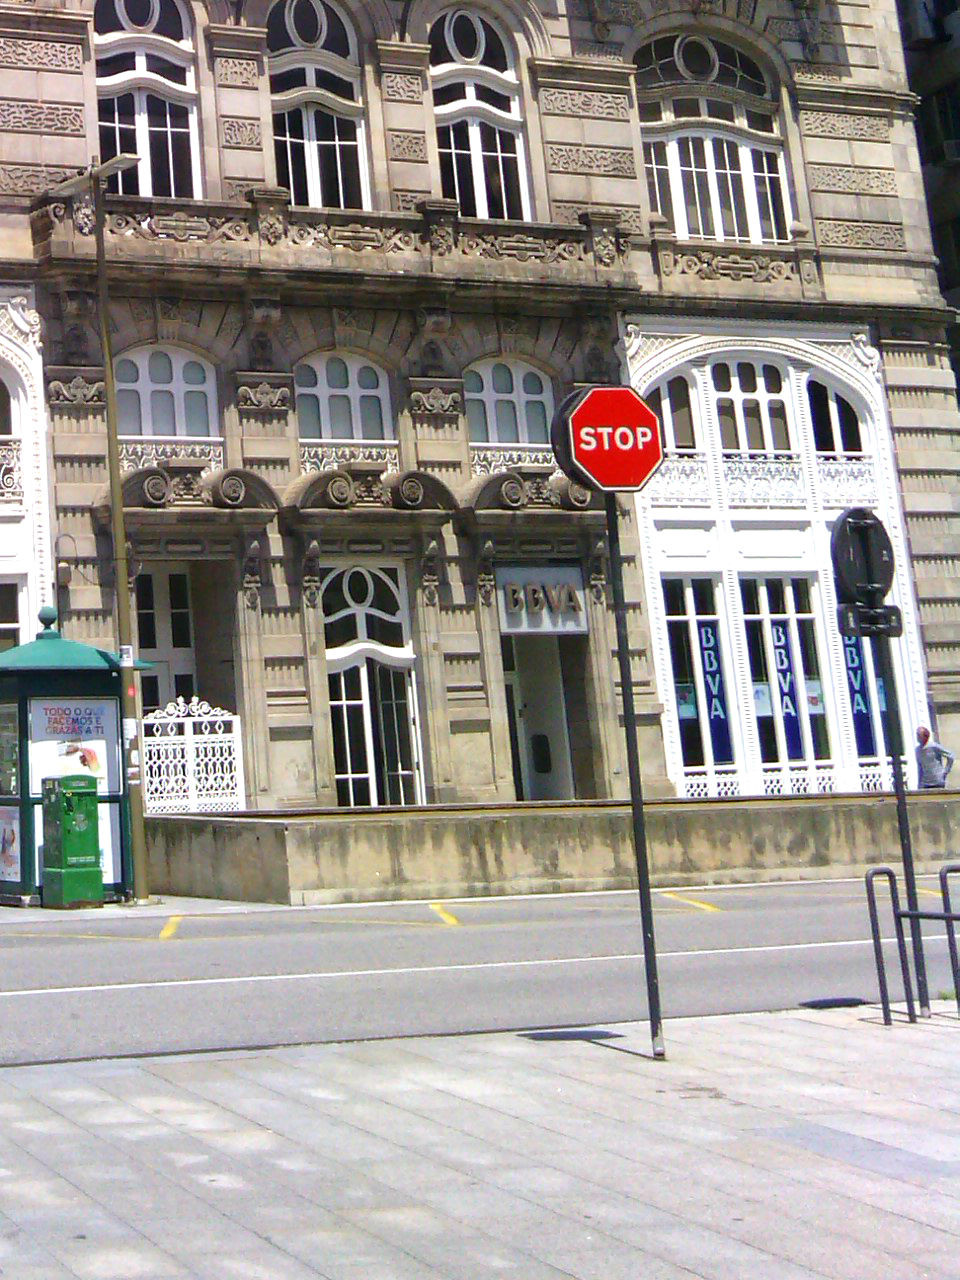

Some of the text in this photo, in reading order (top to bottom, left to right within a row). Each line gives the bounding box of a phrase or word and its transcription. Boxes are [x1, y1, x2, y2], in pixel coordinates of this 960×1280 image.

[580, 426, 652, 451] STOP
[504, 583, 582, 613] BBVA
[701, 626, 726, 720] BBVA
[772, 625, 797, 717] BBVA
[43, 707, 71, 716] TODO
[73, 707, 82, 716] O
[48, 716, 102, 726] FACEMOS E
[46, 726, 104, 735] GRAZAS A TI
